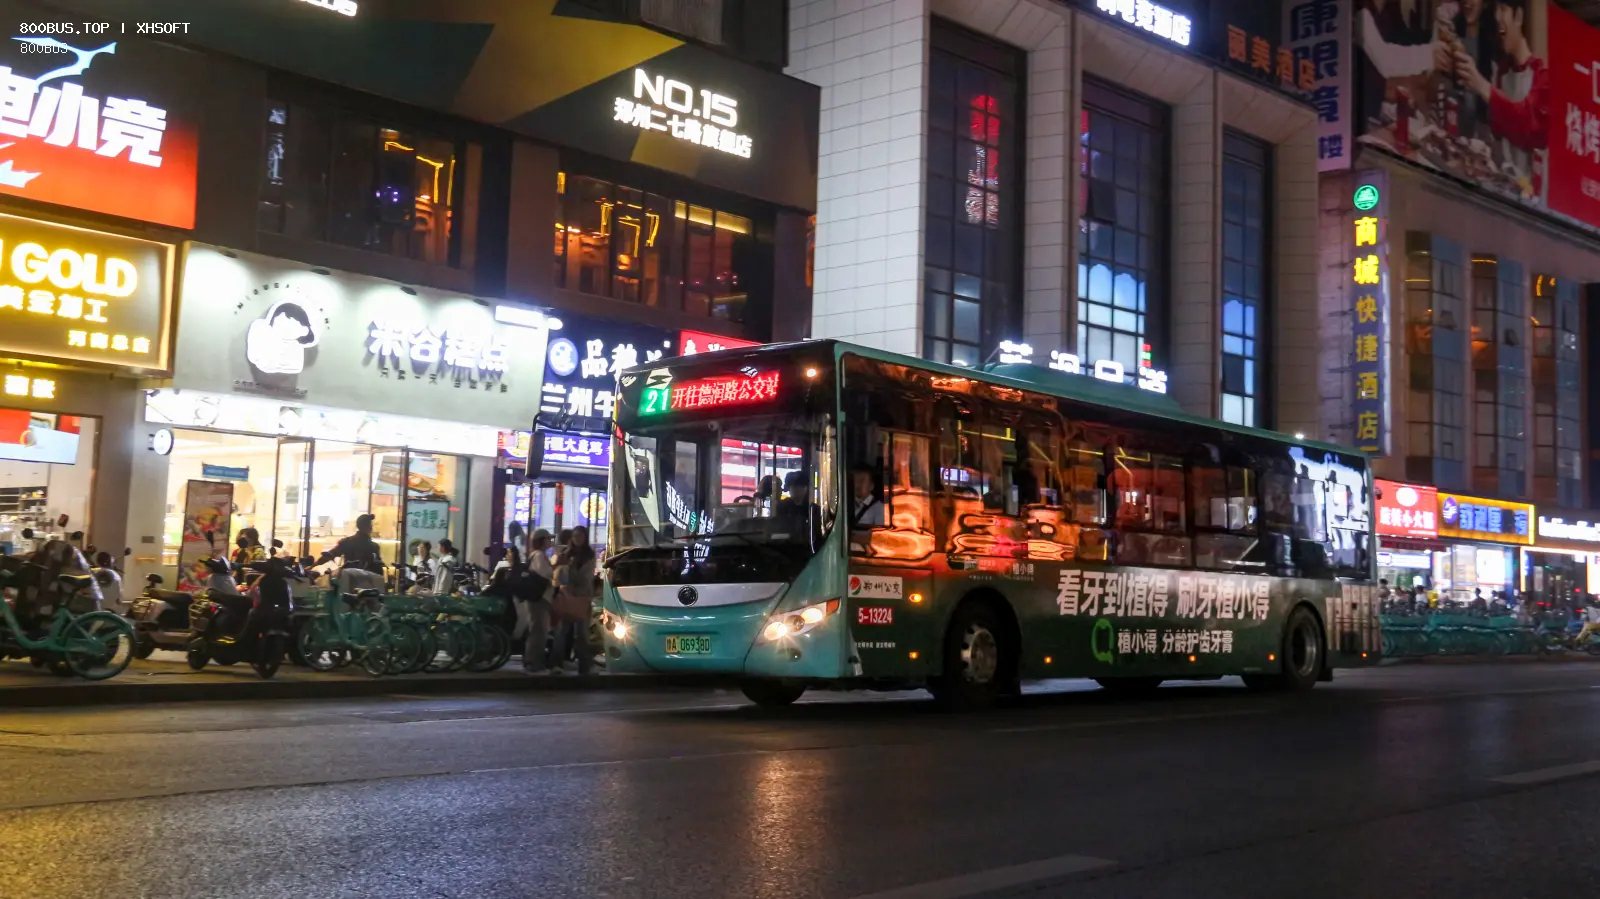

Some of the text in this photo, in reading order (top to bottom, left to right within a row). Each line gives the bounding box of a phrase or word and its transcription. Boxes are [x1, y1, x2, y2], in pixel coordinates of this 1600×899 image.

[633, 68, 738, 128] NO.15
[11, 242, 138, 297] GOLD
[1354, 216, 1379, 450] 商城快捷酒店
[645, 388, 670, 413] 21
[862, 580, 901, 595] 郑州公交
[1056, 569, 1271, 620] 看牙到植得 刷牙植小得
[858, 607, 893, 624] 5-13224
[1118, 629, 1233, 654] 植小得 分龄护齿牙膏
